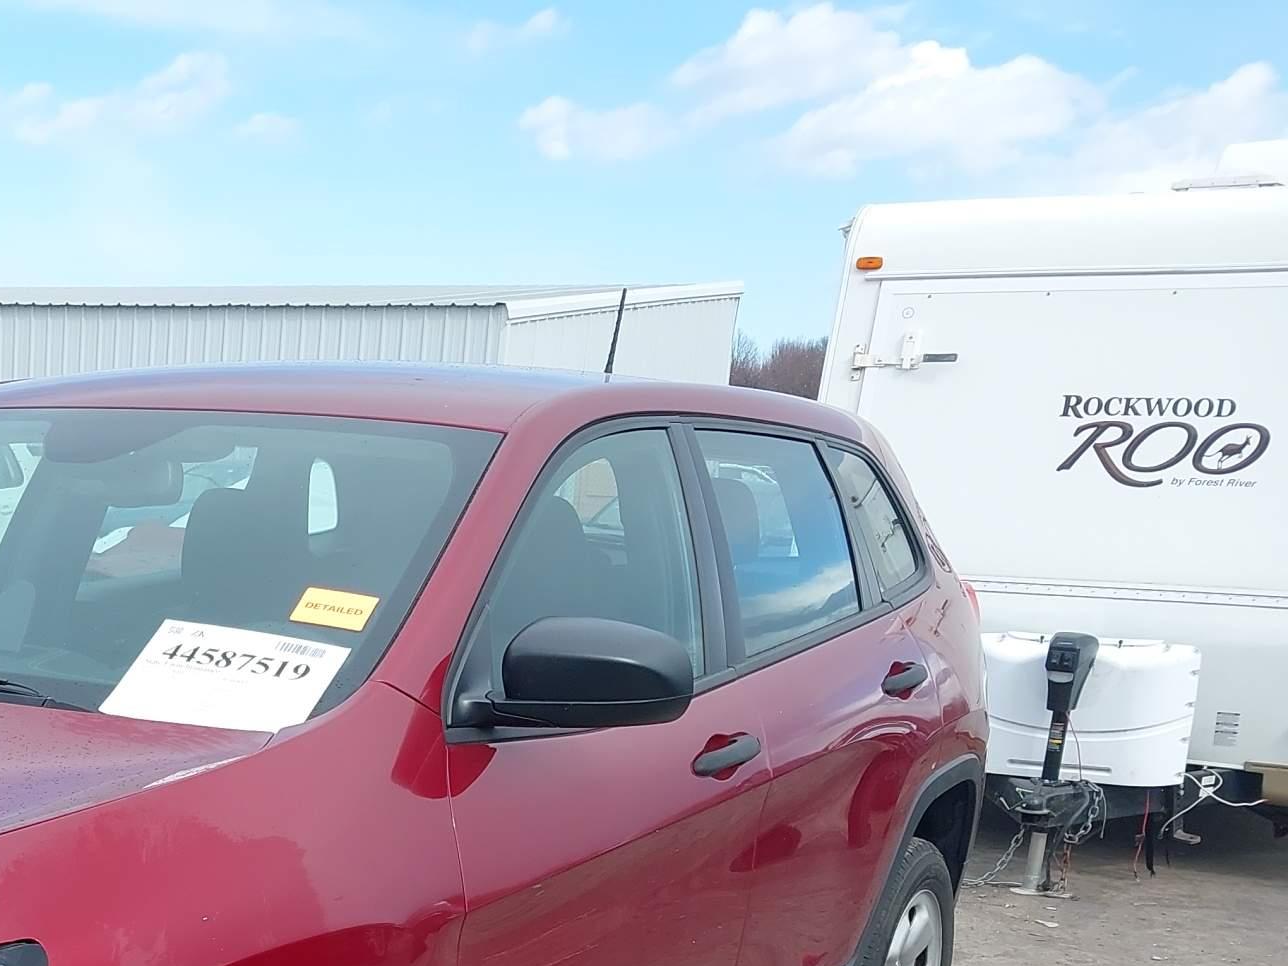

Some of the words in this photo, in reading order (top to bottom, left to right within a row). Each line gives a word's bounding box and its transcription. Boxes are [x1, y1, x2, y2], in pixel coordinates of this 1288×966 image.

[1059, 394, 1237, 418] ROCKWOOD
[1056, 420, 1271, 488] ROO
[1170, 477, 1185, 487] by
[1187, 477, 1224, 487] Forest
[1226, 478, 1257, 488] River
[304, 601, 364, 617] DETAILED
[162, 643, 311, 681] 44587519
